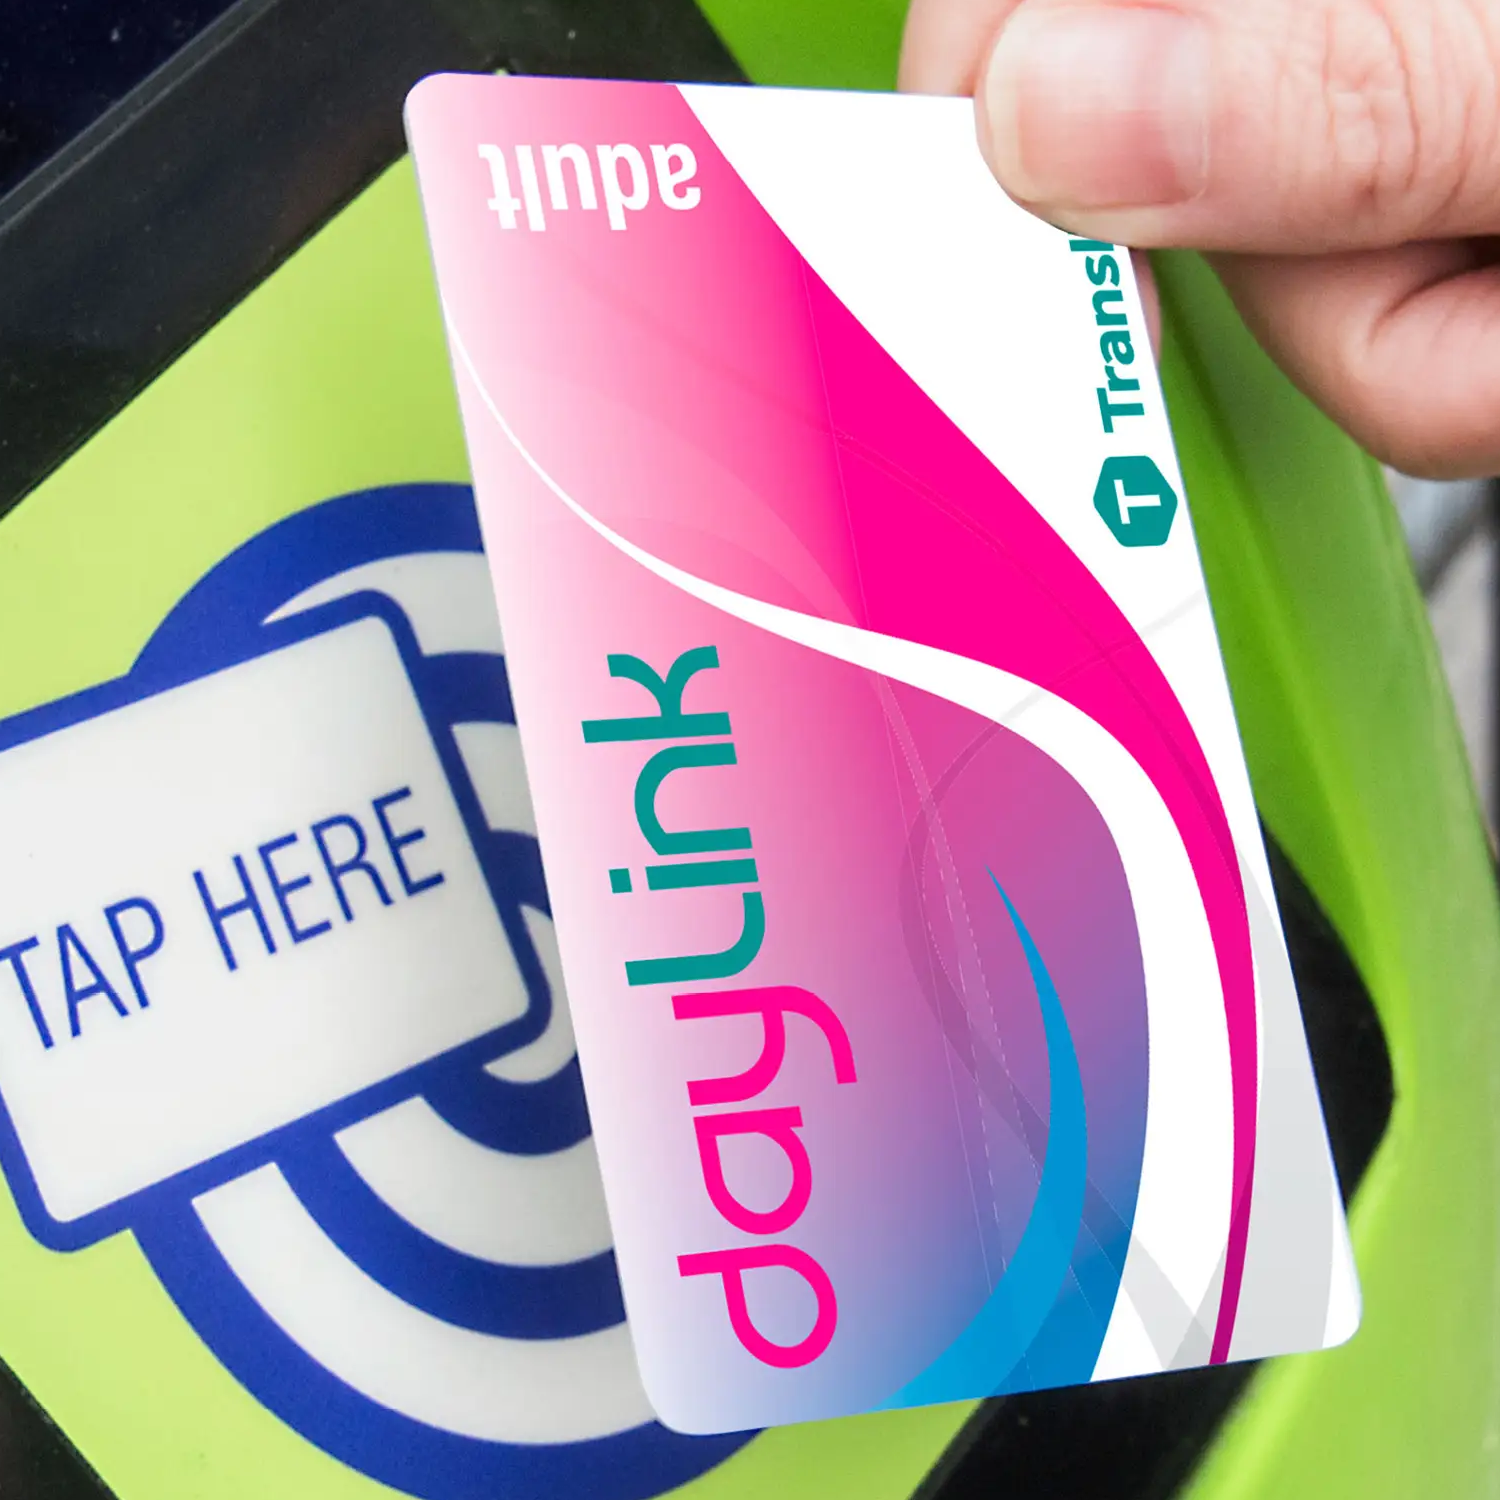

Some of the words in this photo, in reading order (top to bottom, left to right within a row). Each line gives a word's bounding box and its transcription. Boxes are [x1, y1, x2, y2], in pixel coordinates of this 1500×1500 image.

[477, 143, 701, 232] adult
[1067, 233, 1145, 434] Transl
[192, 786, 446, 972] HERE
[581, 645, 857, 1369] dayLink
